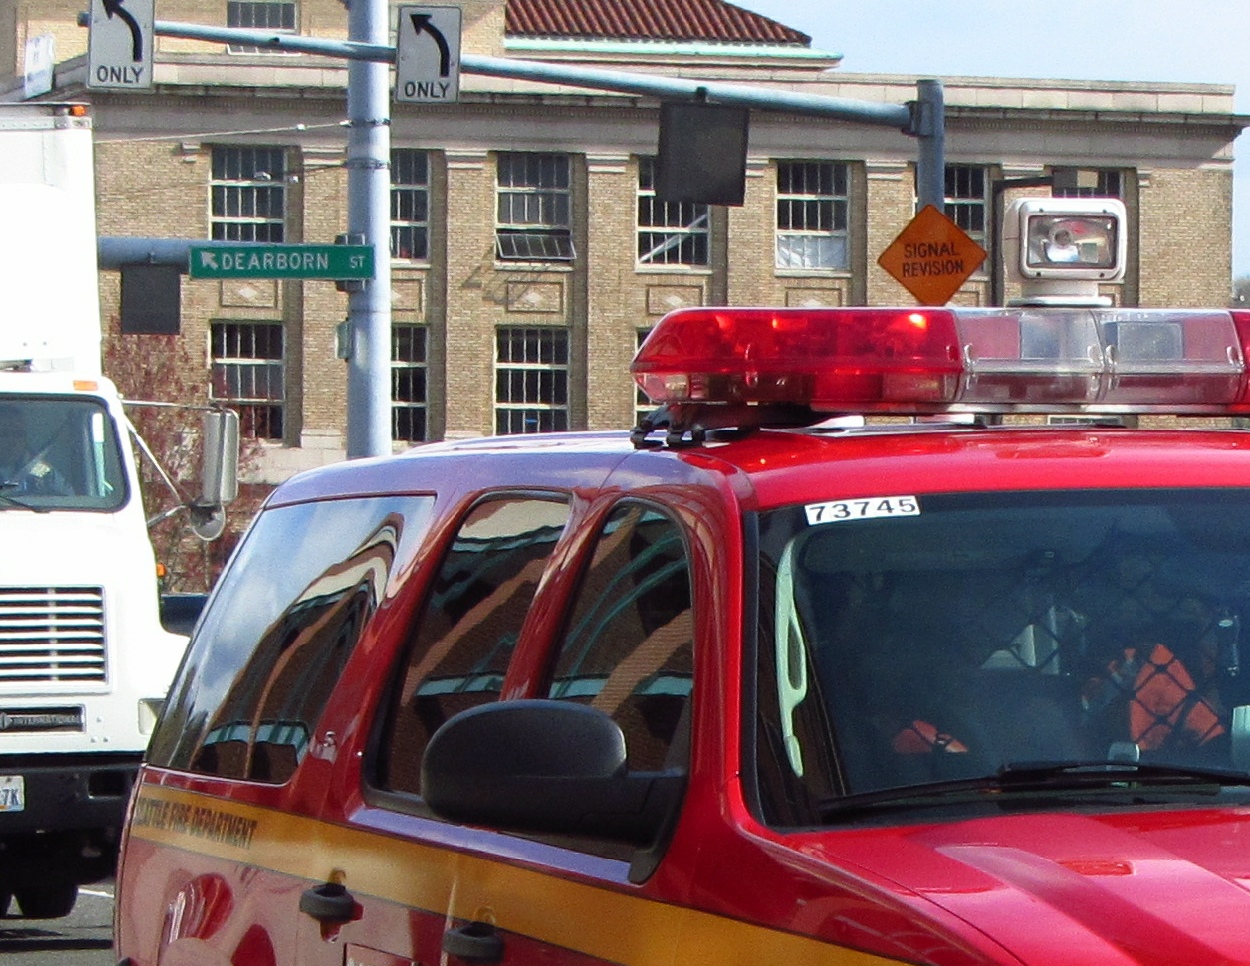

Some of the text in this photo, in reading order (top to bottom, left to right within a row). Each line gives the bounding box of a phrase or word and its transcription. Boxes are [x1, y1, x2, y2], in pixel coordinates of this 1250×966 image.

[96, 65, 144, 84] ONLY
[404, 81, 450, 98] ONLY
[904, 242, 960, 258] SIGNAL
[221, 252, 366, 270] DEARBORN ST
[902, 259, 964, 277] REVISION
[809, 499, 915, 521] 73745
[0, 788, 19, 805] 7K
